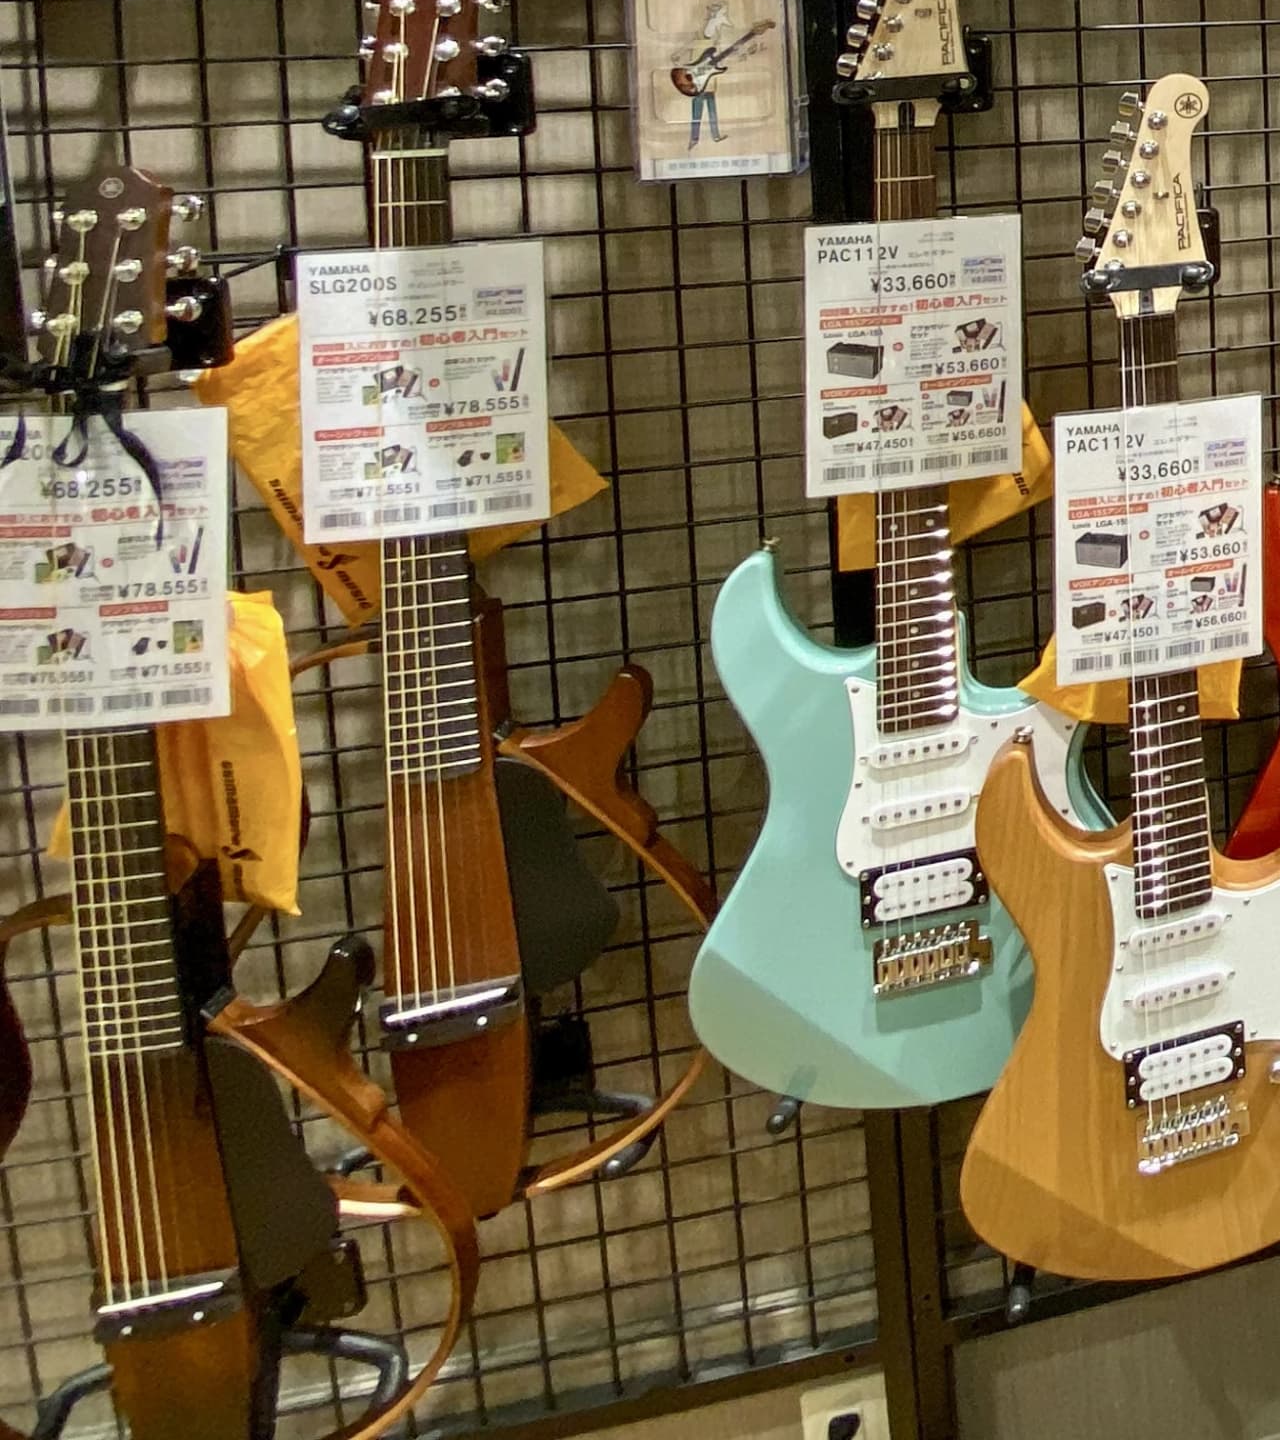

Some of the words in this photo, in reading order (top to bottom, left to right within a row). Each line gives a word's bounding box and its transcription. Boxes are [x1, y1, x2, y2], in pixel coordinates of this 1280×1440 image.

[1173, 172, 1190, 251] PACIFICA
[817, 234, 873, 247] YAMAHA
[817, 245, 899, 264] PAC112V
[308, 263, 371, 277] YAMAHA
[309, 275, 399, 295] SLG200S
[870, 272, 949, 294] ¥33,660
[367, 304, 458, 328] ¥68,255
[1066, 423, 1121, 436] YAMAHA
[1066, 434, 1145, 454] PAC112V
[1118, 458, 1193, 482] ¥33,660
